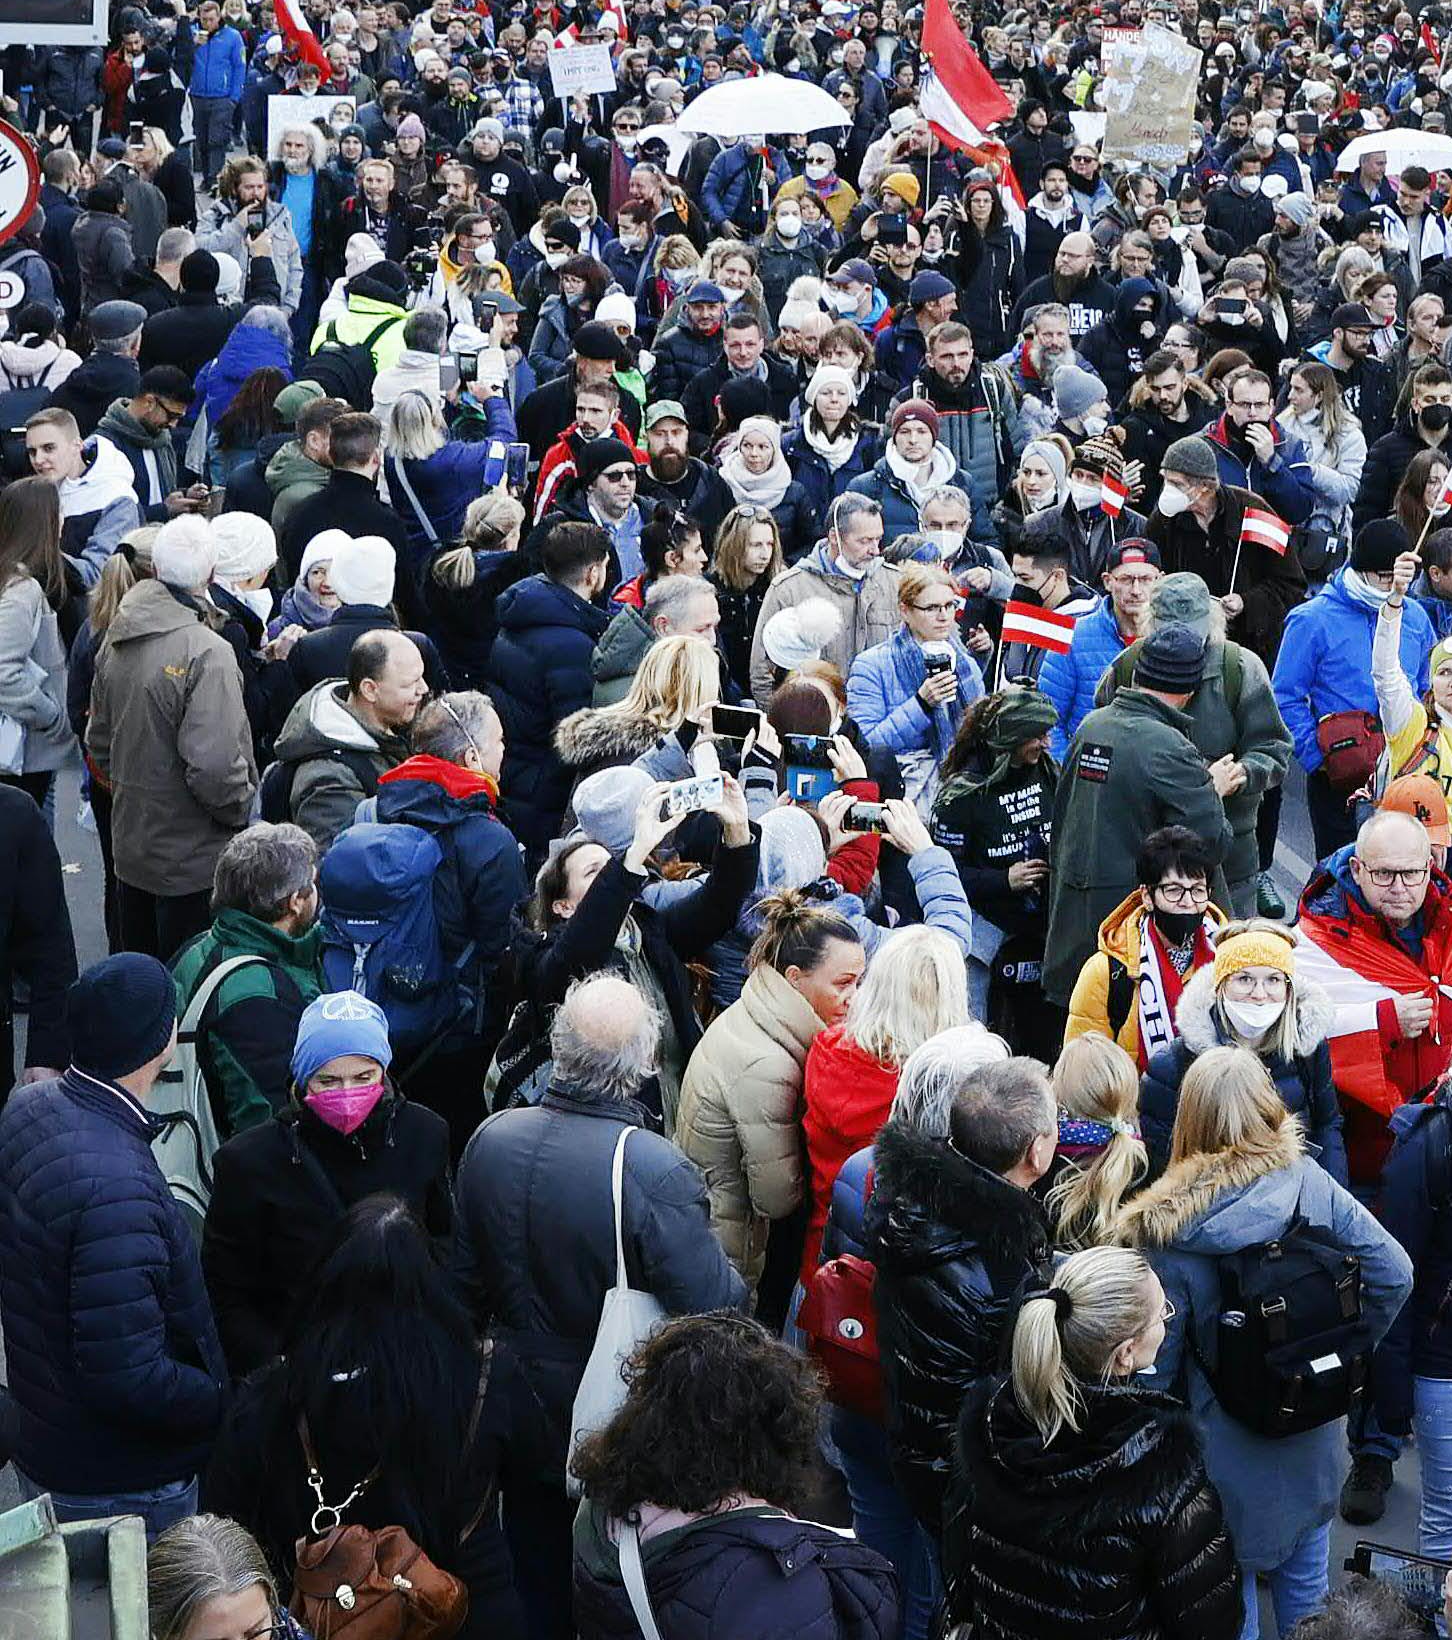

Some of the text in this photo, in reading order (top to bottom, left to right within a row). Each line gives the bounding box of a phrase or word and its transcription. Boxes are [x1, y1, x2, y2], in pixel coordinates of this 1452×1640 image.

[998, 794, 1017, 807] MY
[1006, 804, 1016, 814] is
[1026, 796, 1041, 809] the
[1010, 809, 1042, 825] INSIDE
[1002, 831, 1017, 844] it's
